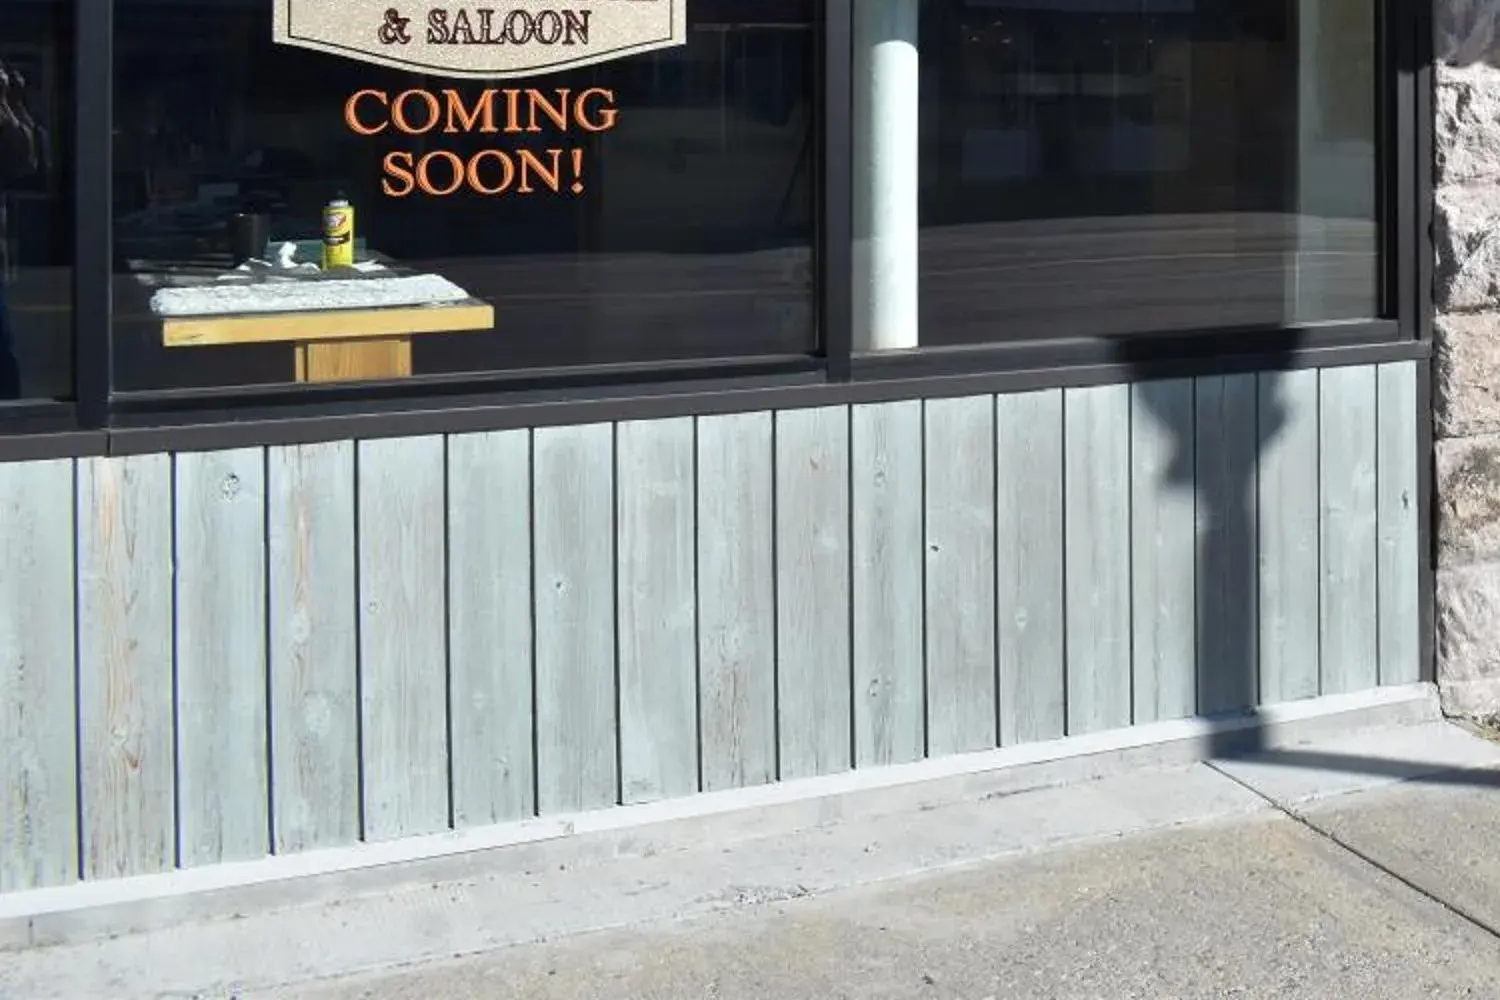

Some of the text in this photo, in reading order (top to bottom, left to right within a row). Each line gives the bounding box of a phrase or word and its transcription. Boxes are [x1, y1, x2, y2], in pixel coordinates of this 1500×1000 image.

[377, 8, 592, 45] & SALOON
[344, 88, 619, 135] COMING
[382, 148, 585, 198] SOON!
